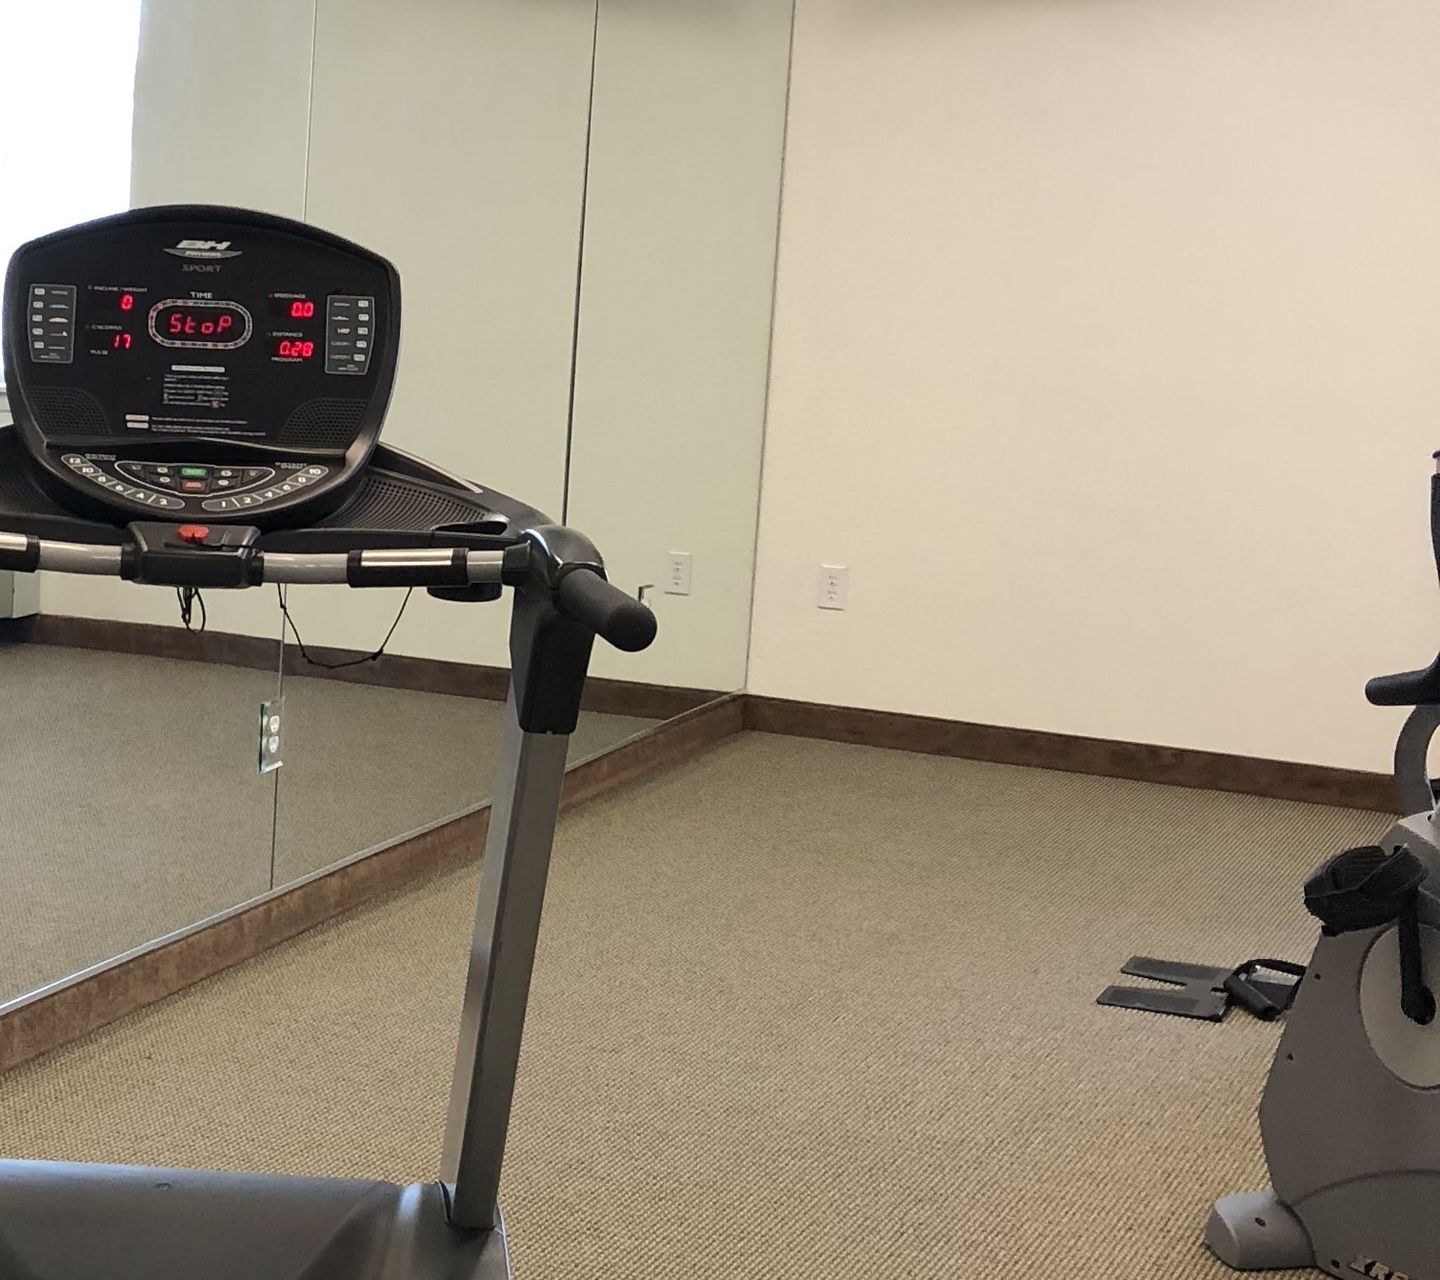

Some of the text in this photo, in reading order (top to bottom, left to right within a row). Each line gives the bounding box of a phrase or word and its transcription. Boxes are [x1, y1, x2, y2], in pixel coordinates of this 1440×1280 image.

[181, 264, 222, 273] SPORT
[190, 291, 213, 299] TIME
[121, 294, 133, 310] 0
[114, 333, 132, 349] 17
